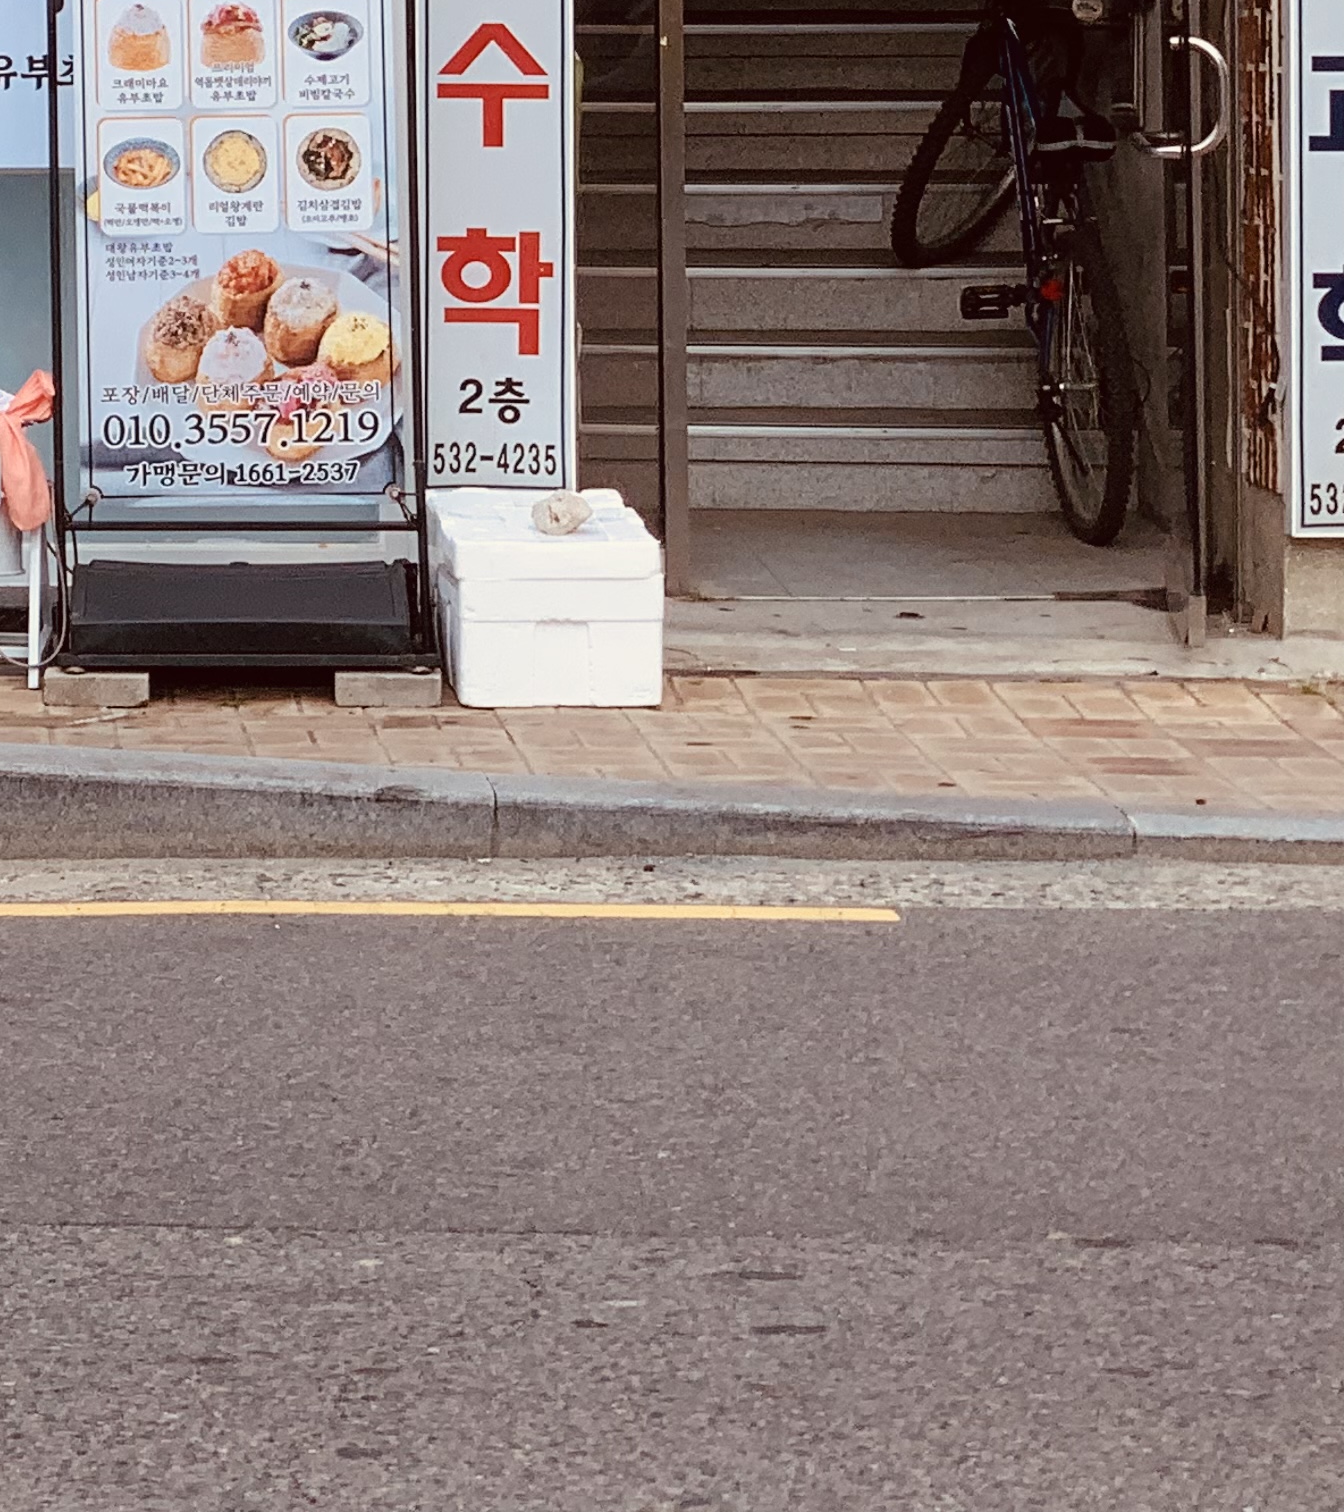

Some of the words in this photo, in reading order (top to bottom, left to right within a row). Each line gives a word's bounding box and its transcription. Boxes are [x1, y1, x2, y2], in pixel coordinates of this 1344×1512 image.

[112, 78, 168, 89] 크래미마요
[304, 73, 350, 85] 수제고기
[117, 92, 164, 104] 유부초밥
[211, 90, 257, 102] 유부초밥
[299, 88, 355, 100] 비빔칼국수
[114, 202, 171, 214] 국물떡볶이
[209, 200, 264, 212] 리얼왕계란
[297, 198, 362, 211] 김치삼겹김밥
[225, 215, 247, 227] 김밥
[105, 242, 173, 254] 대왕유부초밥
[100, 381, 381, 405] 포장/배달/단체주문/예약/문의
[459, 377, 531, 425] 2층
[103, 410, 380, 450] 010.3557.1219
[432, 442, 557, 477] 532-4235
[126, 463, 228, 486] 가맹문의
[237, 462, 360, 484] 1661-2537
